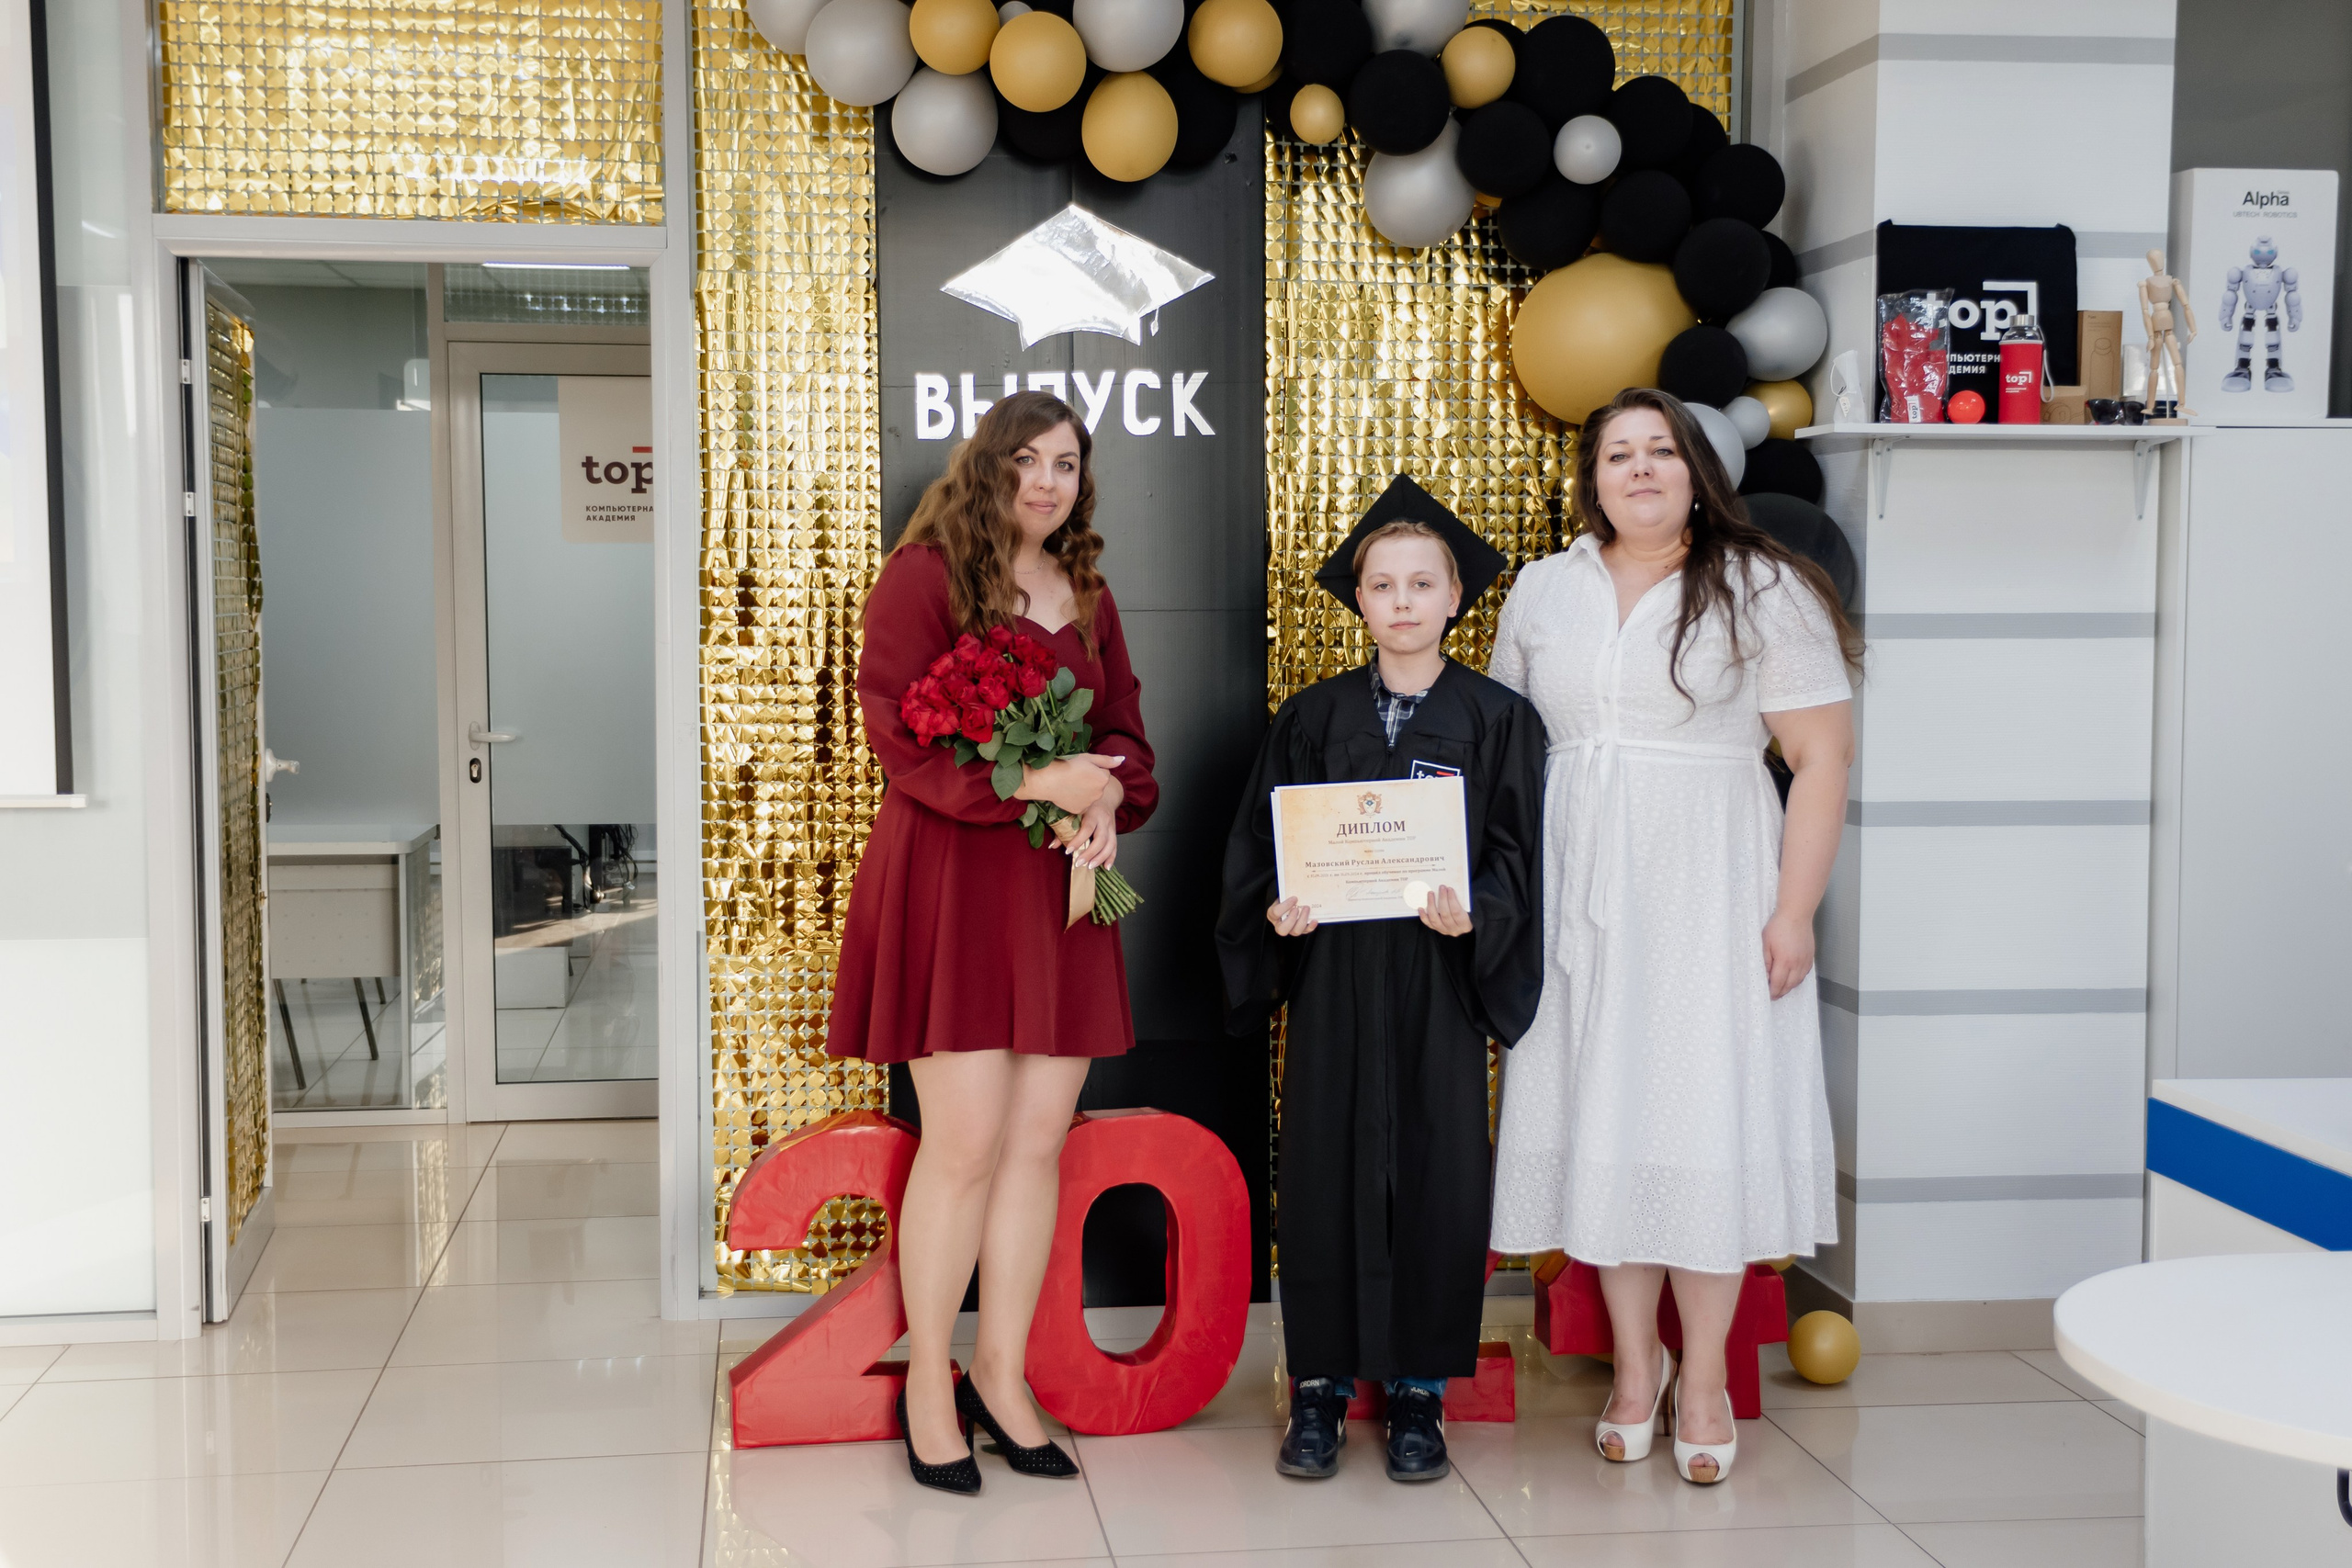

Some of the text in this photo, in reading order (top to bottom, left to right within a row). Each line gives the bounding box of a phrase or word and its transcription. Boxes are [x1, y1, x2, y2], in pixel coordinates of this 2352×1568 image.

[2243, 191, 2289, 209] Alpha
[1921, 292, 2018, 341] top
[1946, 354, 2001, 363] ПЬЮТЕРН
[1947, 366, 1986, 375] ДЕМИЯ
[2005, 374, 2028, 386] top
[581, 456, 653, 494] top
[1336, 820, 1407, 838] ДИПЛОМ
[1305, 855, 1445, 868] Мазовский Руслан Александрович
